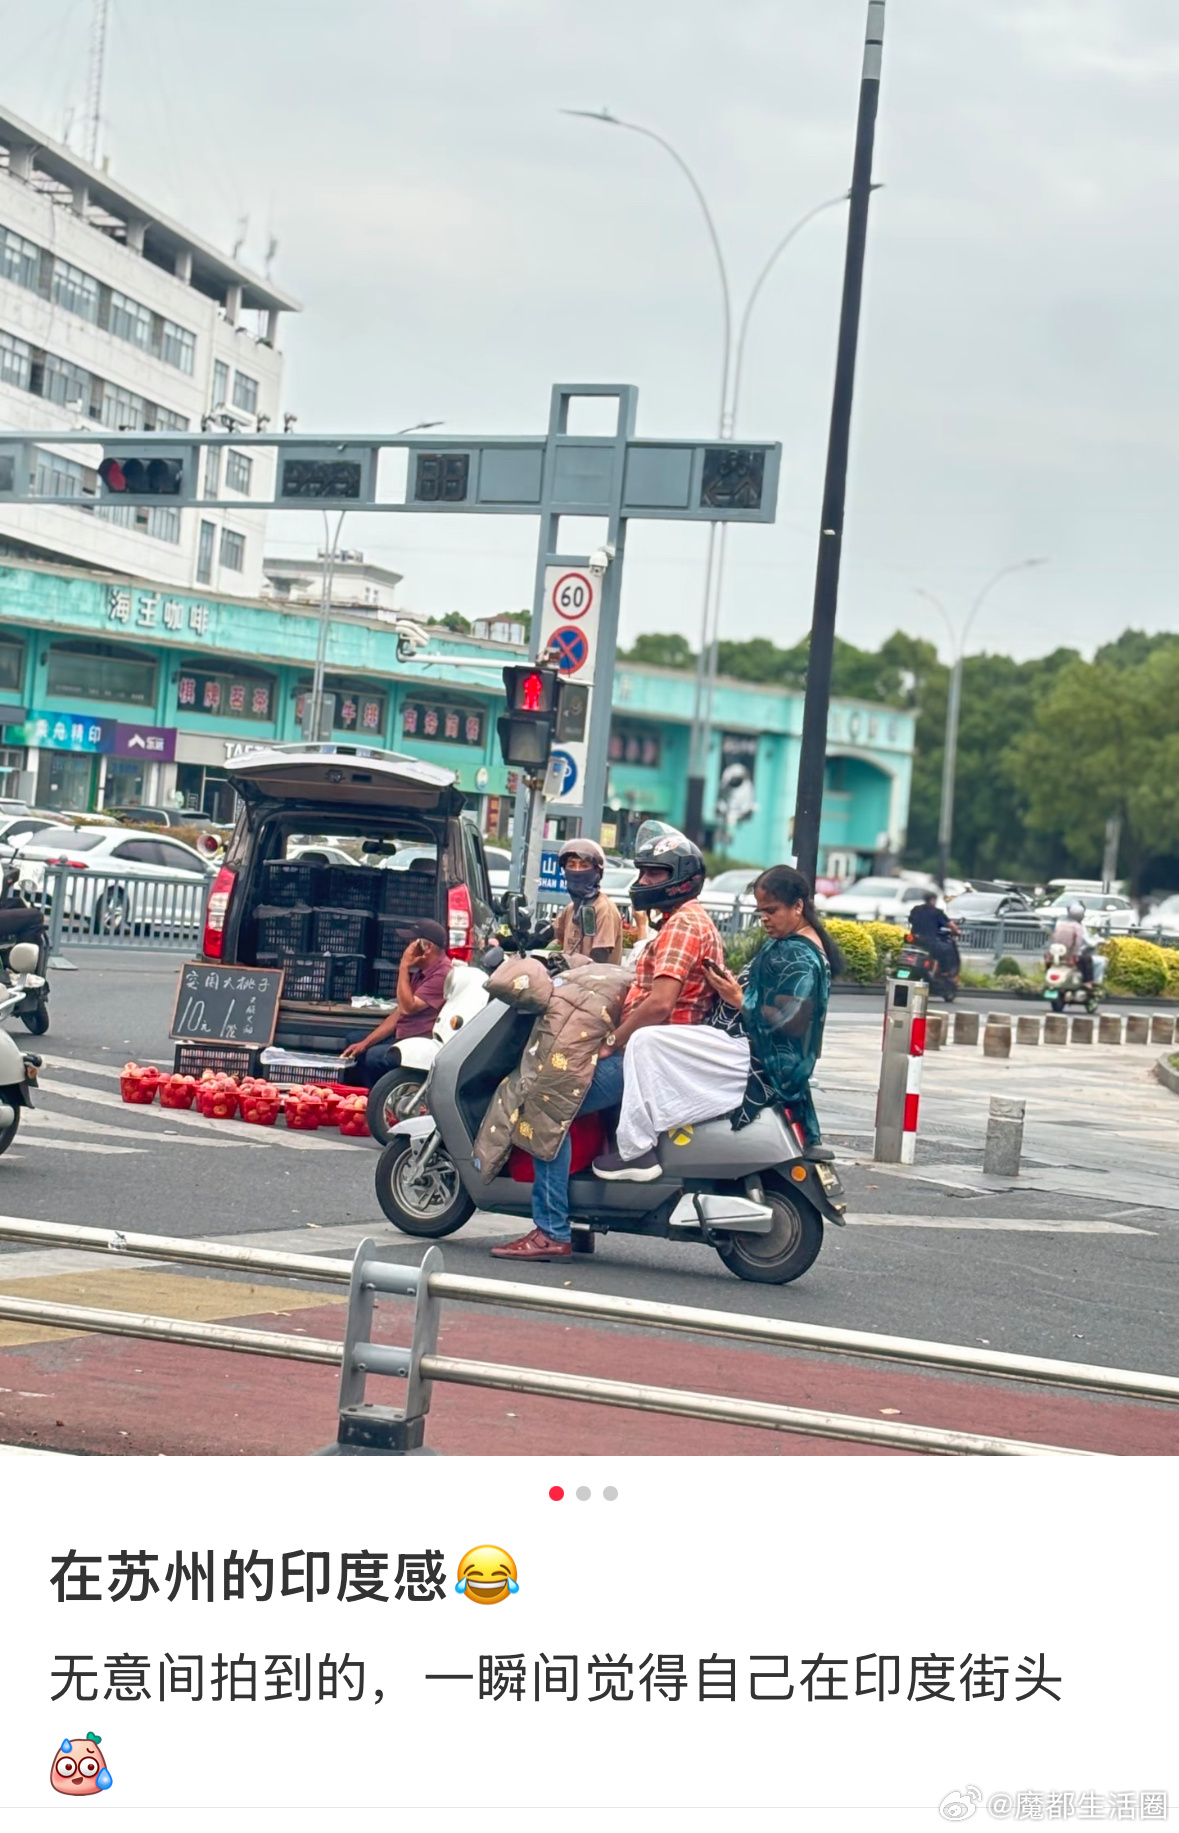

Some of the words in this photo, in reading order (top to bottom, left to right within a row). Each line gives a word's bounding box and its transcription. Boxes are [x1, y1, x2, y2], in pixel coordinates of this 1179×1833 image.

[110, 590, 208, 634] 海王咖啡
[561, 586, 584, 608] 60
